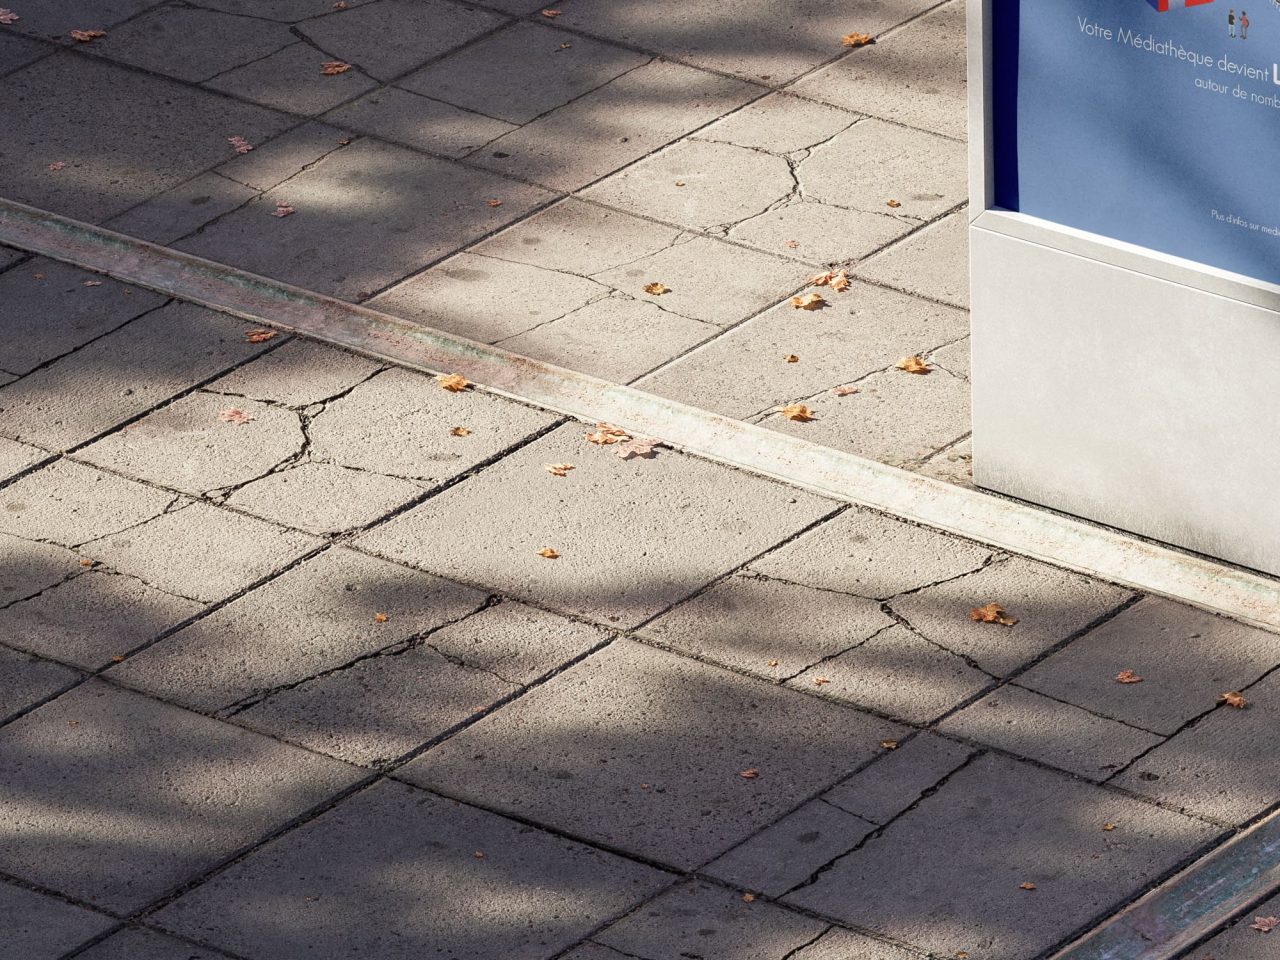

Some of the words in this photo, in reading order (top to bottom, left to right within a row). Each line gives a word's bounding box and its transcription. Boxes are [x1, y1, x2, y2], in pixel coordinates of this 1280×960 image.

[1077, 15, 1112, 40] Votre
[1117, 27, 1213, 68] Médiathèque
[1217, 54, 1270, 81] devient
[1194, 77, 1229, 95] autour
[1232, 84, 1248, 100] de
[1211, 209, 1225, 221] Plus
[1249, 222, 1260, 231] sur
